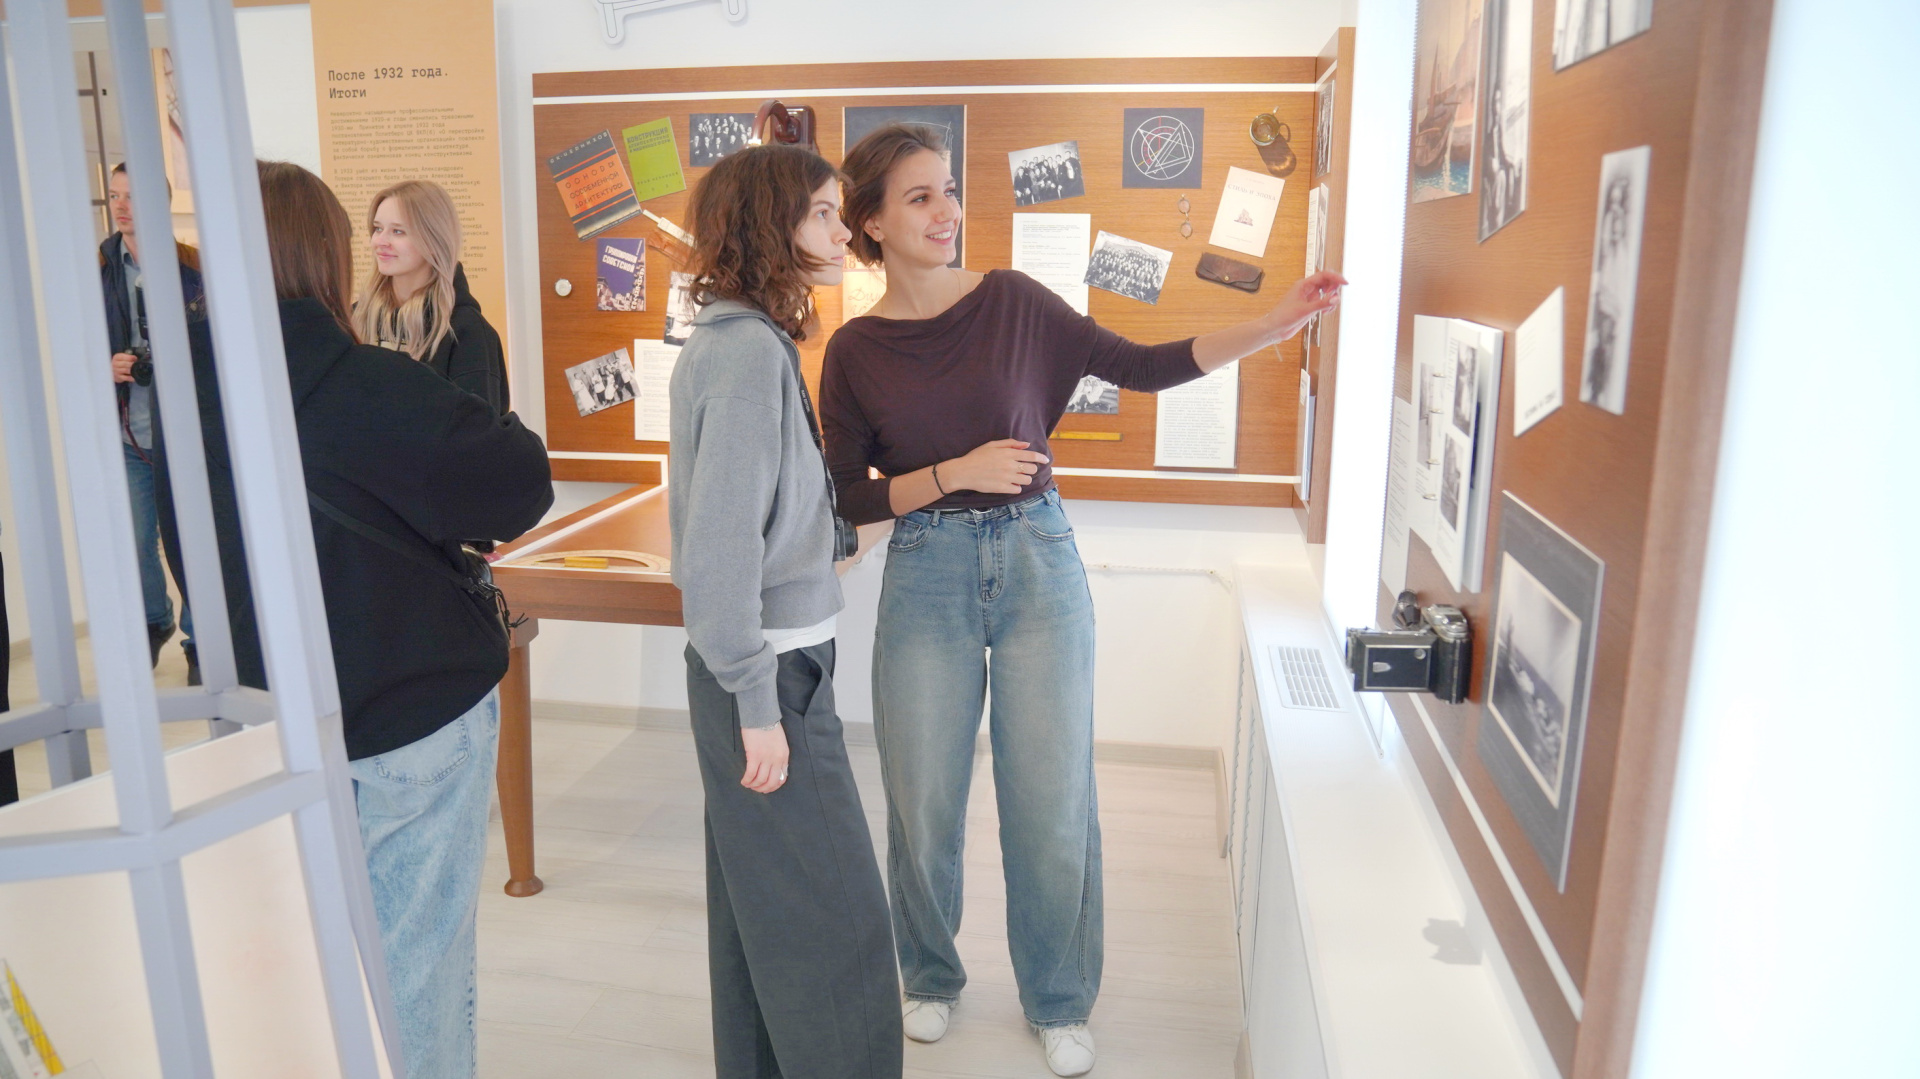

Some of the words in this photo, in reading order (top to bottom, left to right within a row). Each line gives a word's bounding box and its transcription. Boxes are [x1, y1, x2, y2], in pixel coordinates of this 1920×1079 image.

[328, 70, 365, 81] После
[374, 67, 404, 79] 1932
[411, 67, 448, 78] года.
[329, 87, 367, 99] Итоги
[626, 126, 668, 143] КОНСТРУКЦИЯ
[569, 171, 619, 199] СОВРЕМЕННОЙ
[574, 182, 623, 210] АРХИТЕКТУРЫ
[1256, 192, 1276, 200] ЭПОХА
